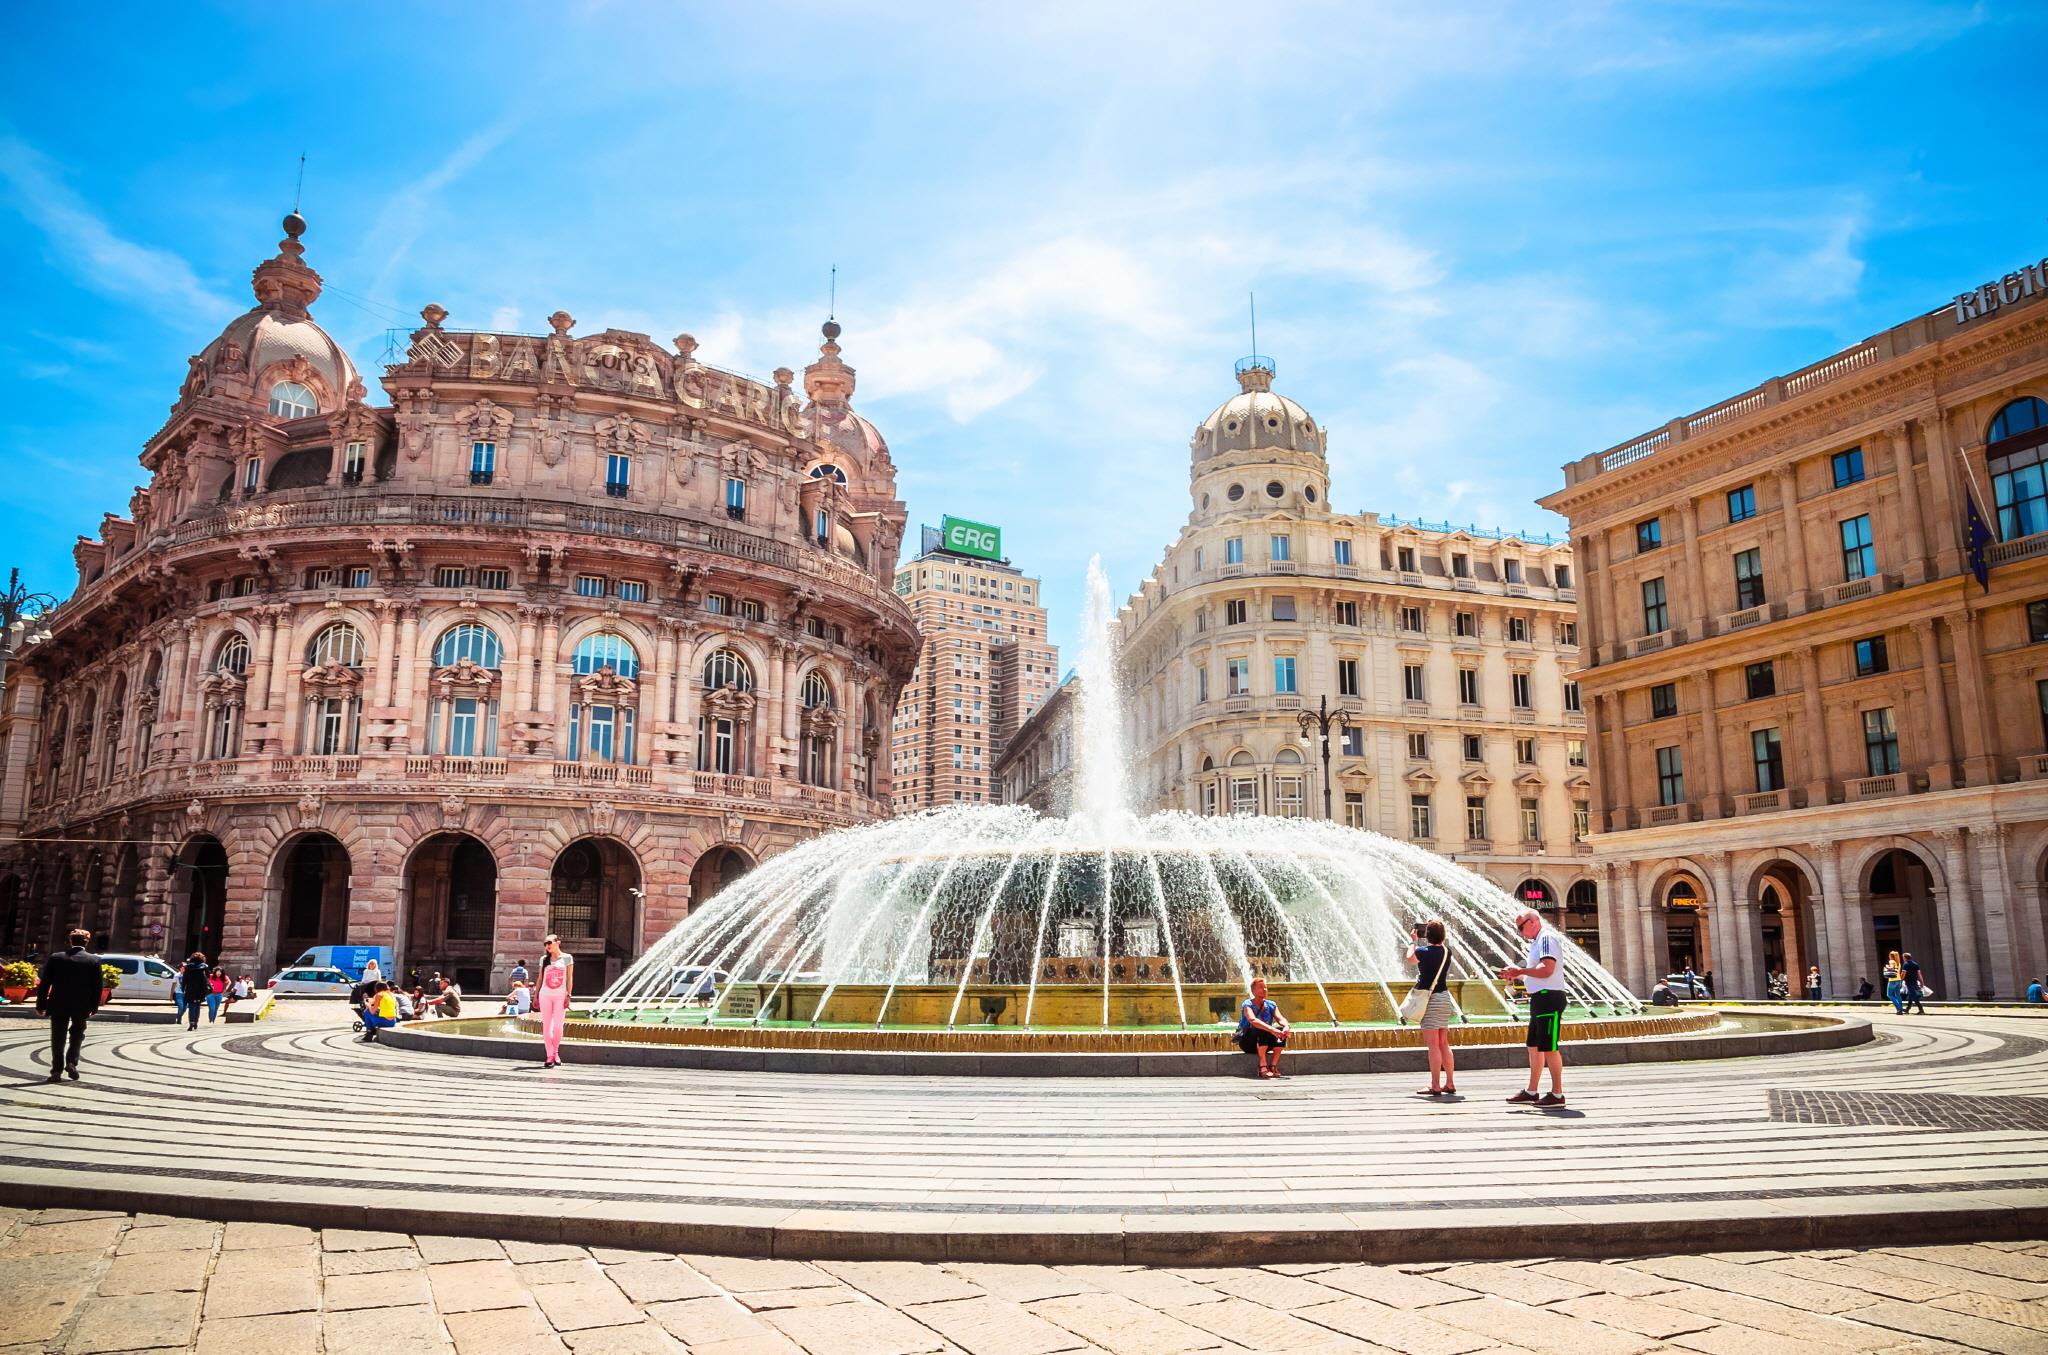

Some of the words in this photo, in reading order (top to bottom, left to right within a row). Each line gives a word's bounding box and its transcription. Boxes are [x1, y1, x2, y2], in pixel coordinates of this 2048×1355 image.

[469, 333, 666, 400] BANCA
[950, 525, 996, 552] ERG
[1526, 890, 1543, 899] BAR
